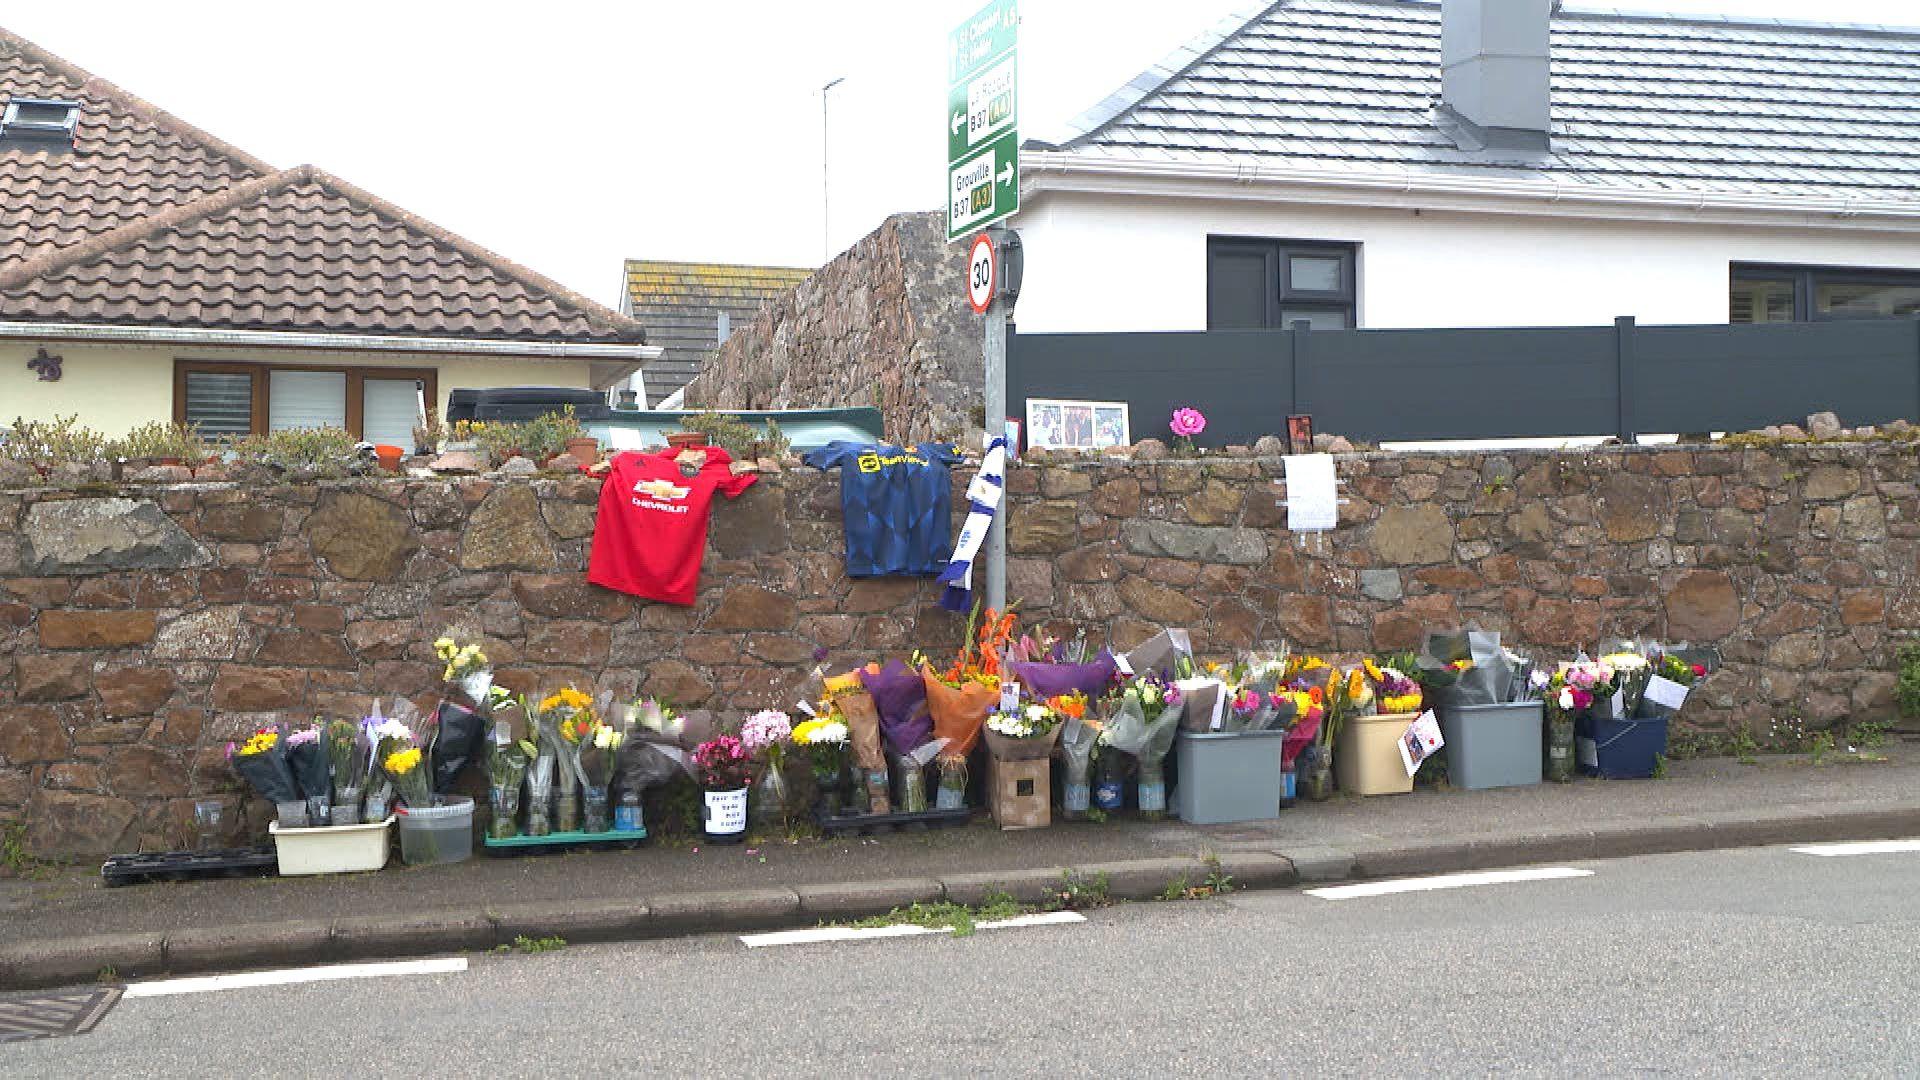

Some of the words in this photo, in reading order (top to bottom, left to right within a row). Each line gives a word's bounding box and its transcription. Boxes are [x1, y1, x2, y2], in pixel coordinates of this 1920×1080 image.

[970, 109, 987, 132] B37
[956, 163, 990, 192] Grouville
[954, 197, 970, 219] B37
[971, 185, 993, 214] (A3)
[973, 257, 990, 290] 30
[632, 497, 689, 514] CHEVROLET
